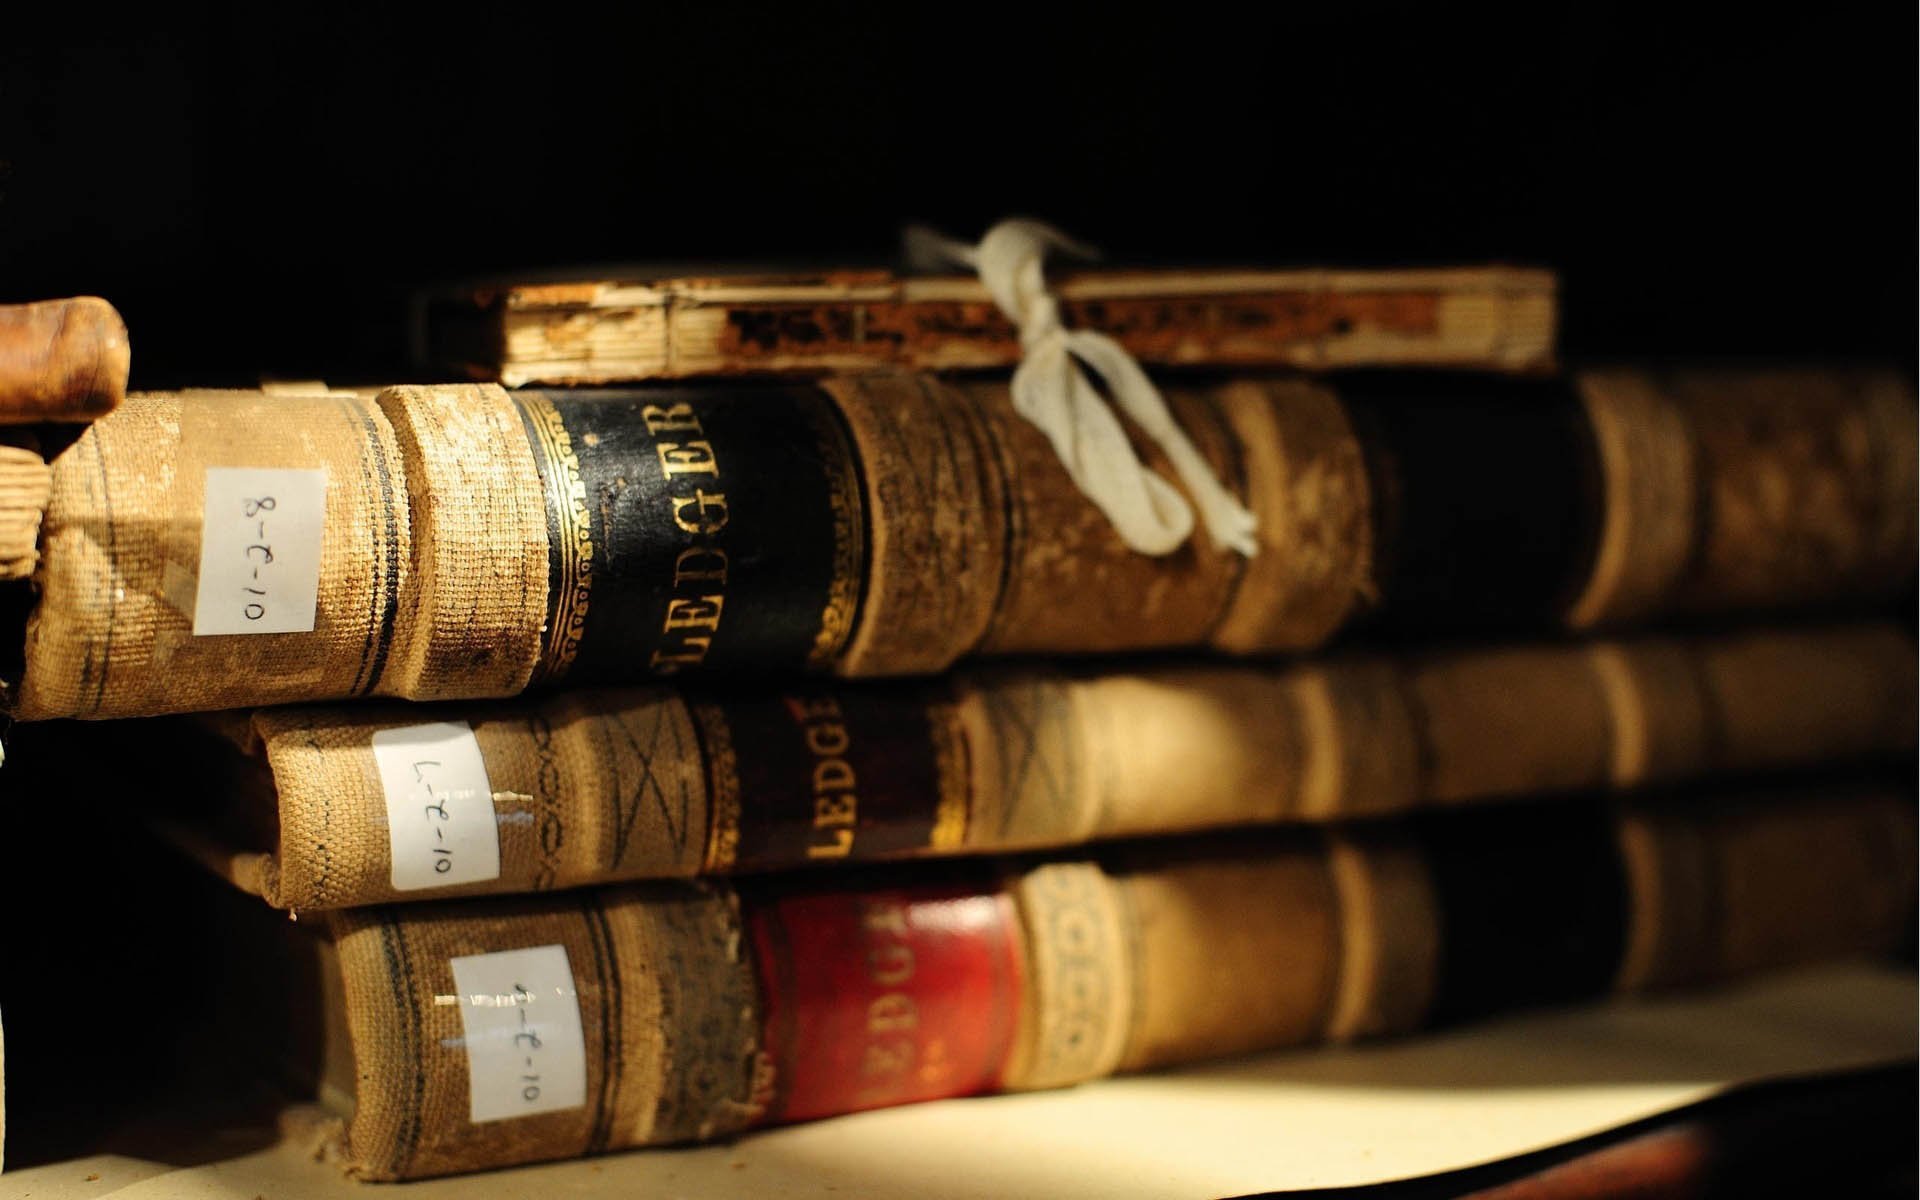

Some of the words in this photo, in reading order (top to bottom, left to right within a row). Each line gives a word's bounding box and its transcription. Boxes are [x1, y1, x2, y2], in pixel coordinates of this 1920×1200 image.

[242, 496, 276, 620] 01-2-8
[641, 403, 729, 670] LEDGER
[413, 760, 453, 874] 01-2-7
[513, 982, 543, 1101] 01-2-
